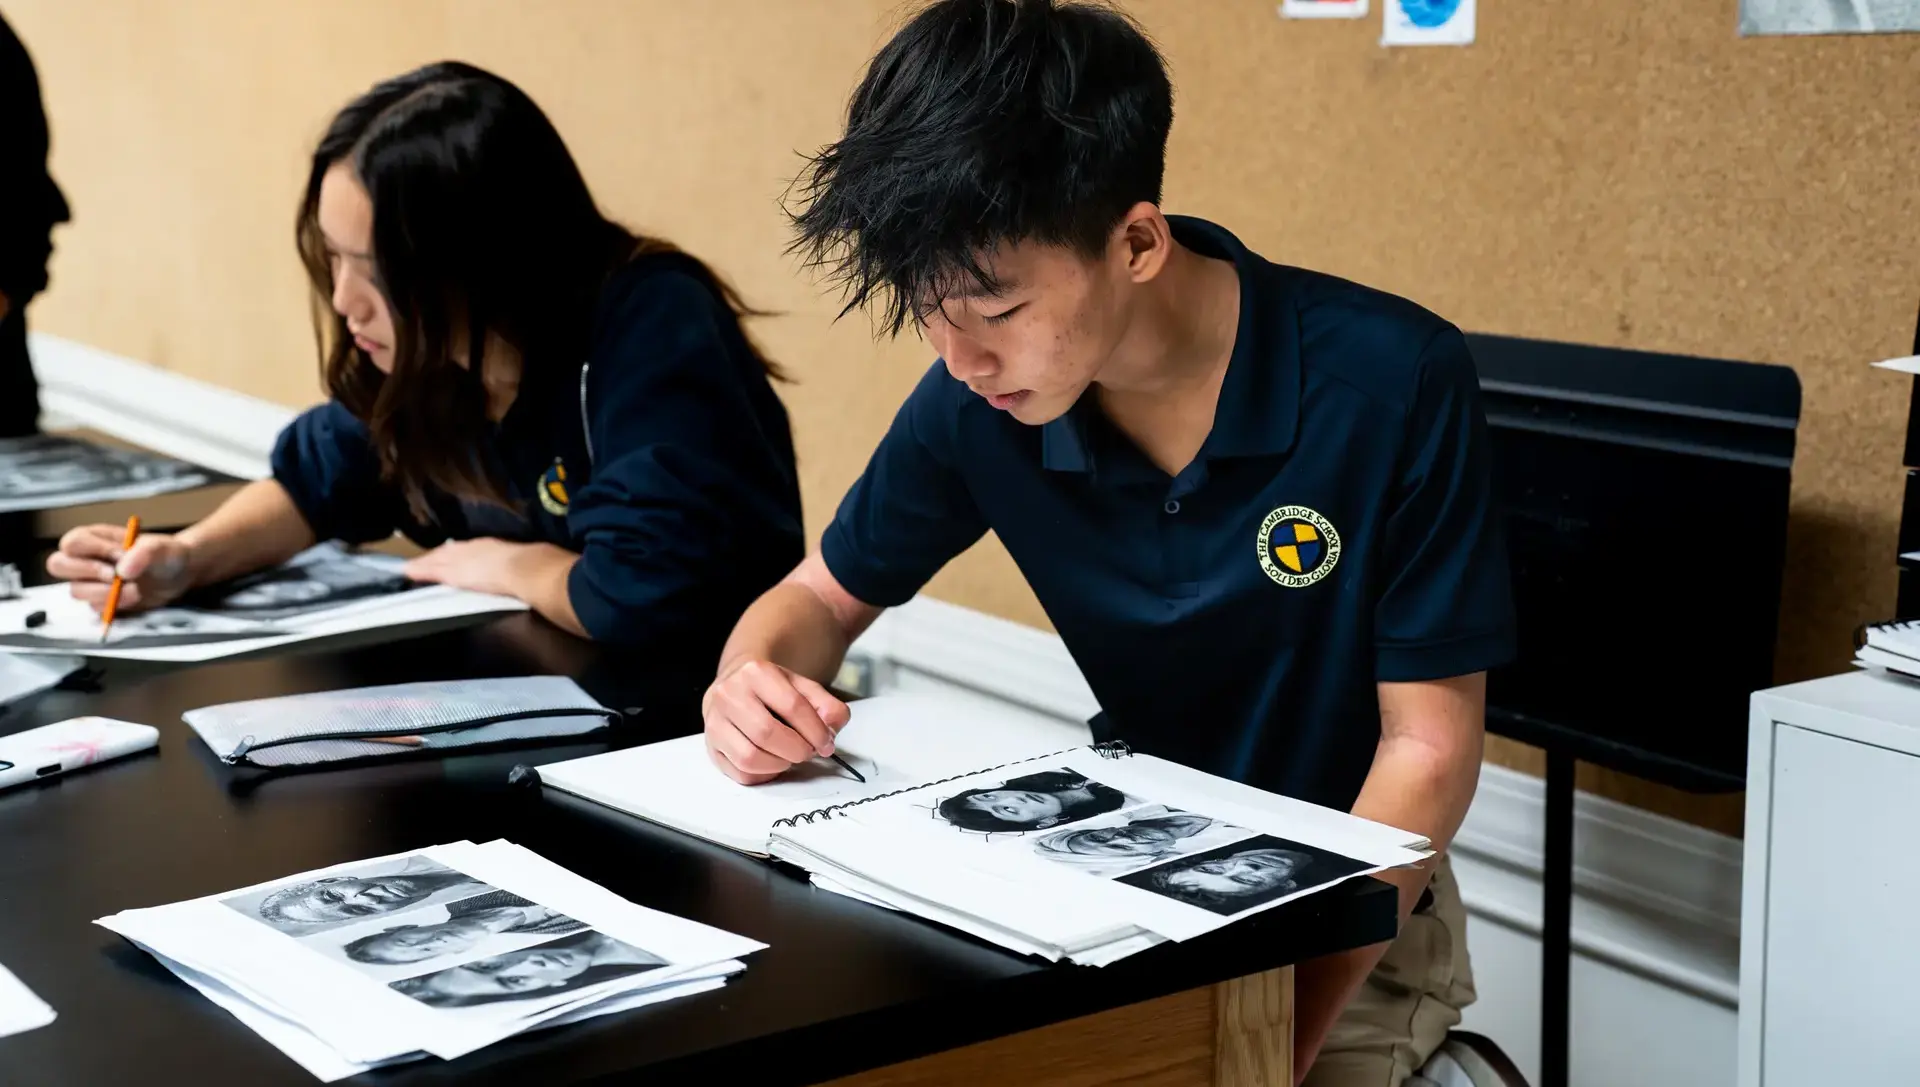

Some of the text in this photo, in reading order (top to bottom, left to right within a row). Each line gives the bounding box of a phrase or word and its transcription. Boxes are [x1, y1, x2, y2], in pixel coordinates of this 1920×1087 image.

[1259, 508, 1338, 561] THE CAMBRIDGE SCHOOL
[1265, 551, 1338, 585] SOLI DEO GLORIA
